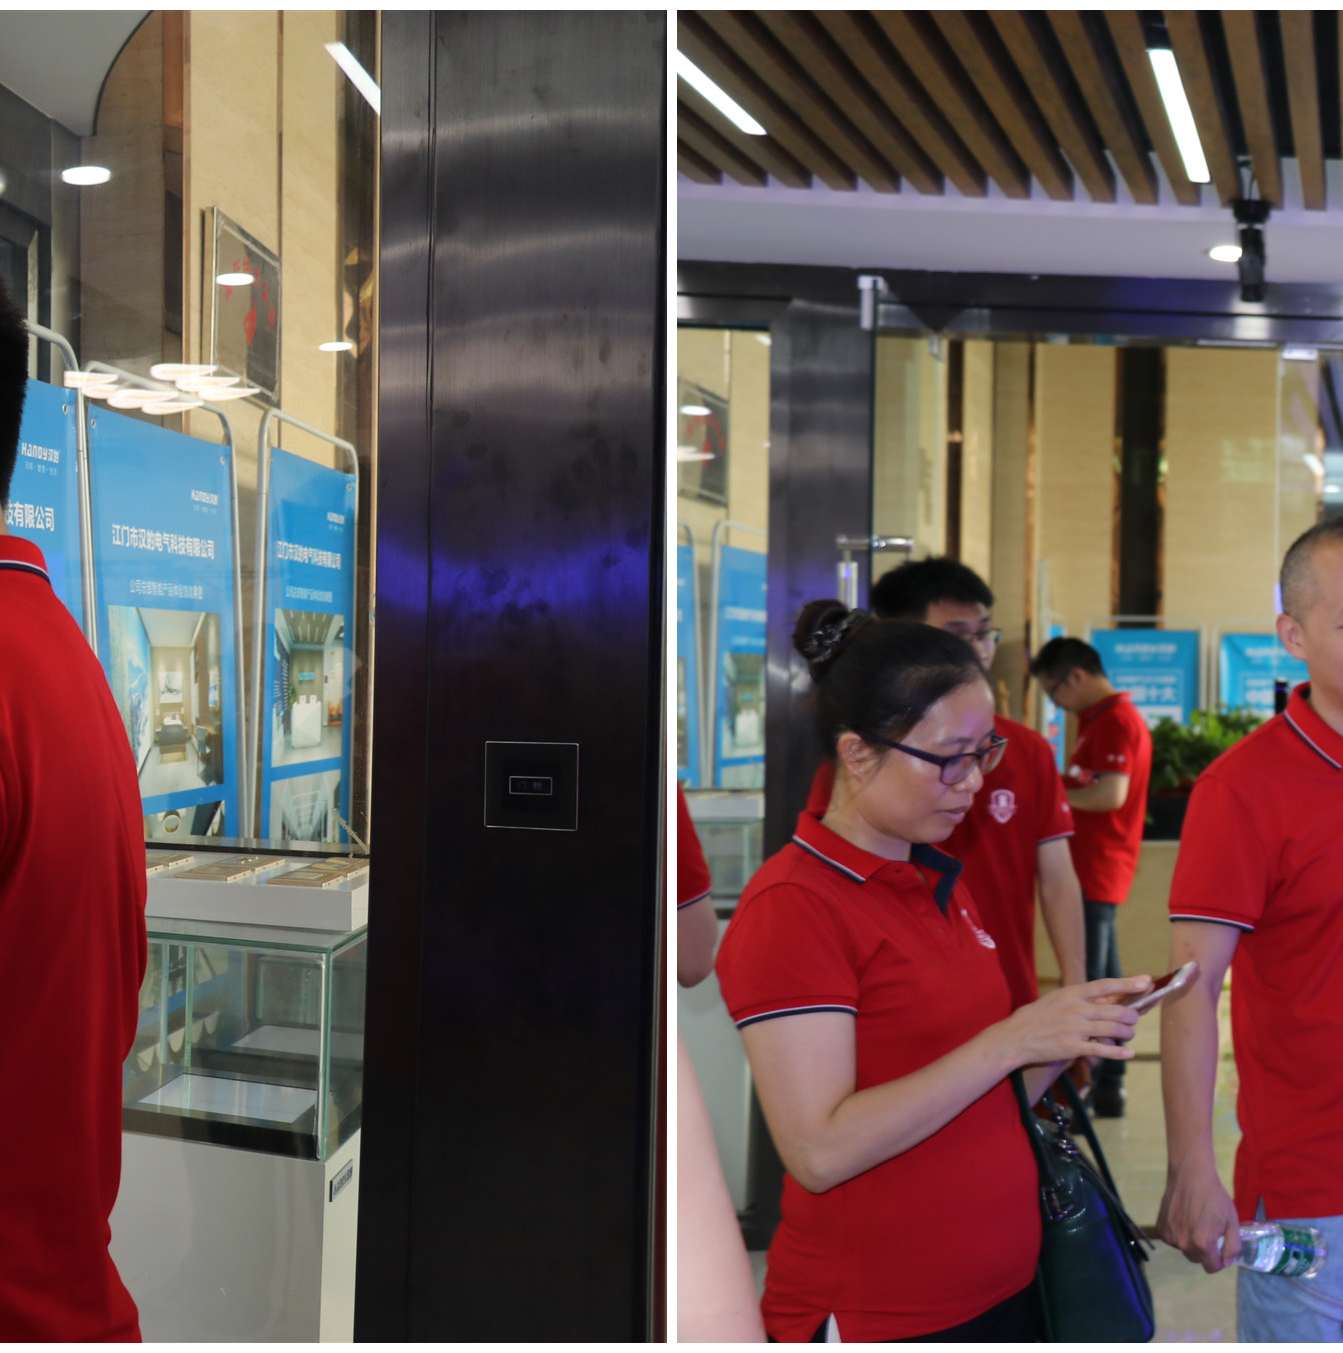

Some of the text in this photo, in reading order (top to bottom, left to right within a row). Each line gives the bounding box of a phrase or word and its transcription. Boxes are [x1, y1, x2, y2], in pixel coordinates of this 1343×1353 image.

[112, 523, 215, 560] 江门市汉的电气科技有限公司
